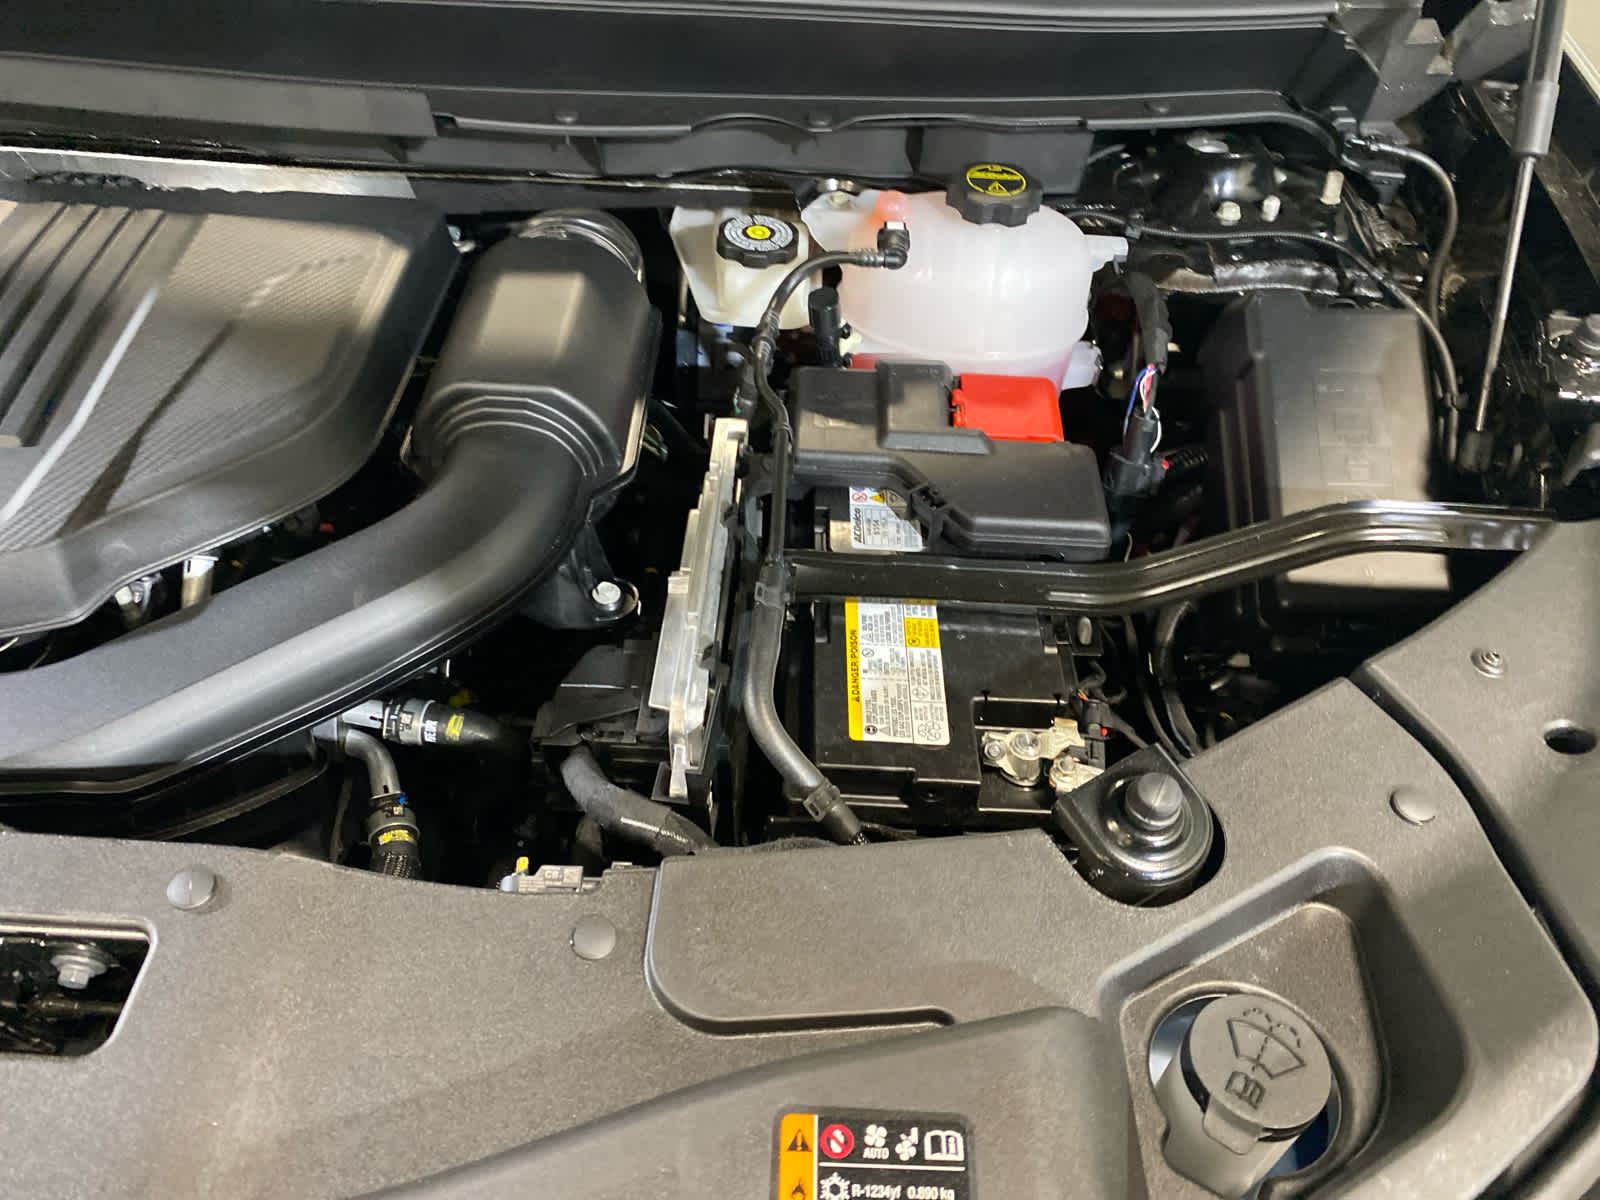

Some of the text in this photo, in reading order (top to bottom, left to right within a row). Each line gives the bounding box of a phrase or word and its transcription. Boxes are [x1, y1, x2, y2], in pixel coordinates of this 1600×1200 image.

[849, 629, 860, 696] DANGER POISON
[862, 1147, 889, 1160] AUTO
[851, 1183, 902, 1200] R-1234yf
[939, 1186, 955, 1200] kg
